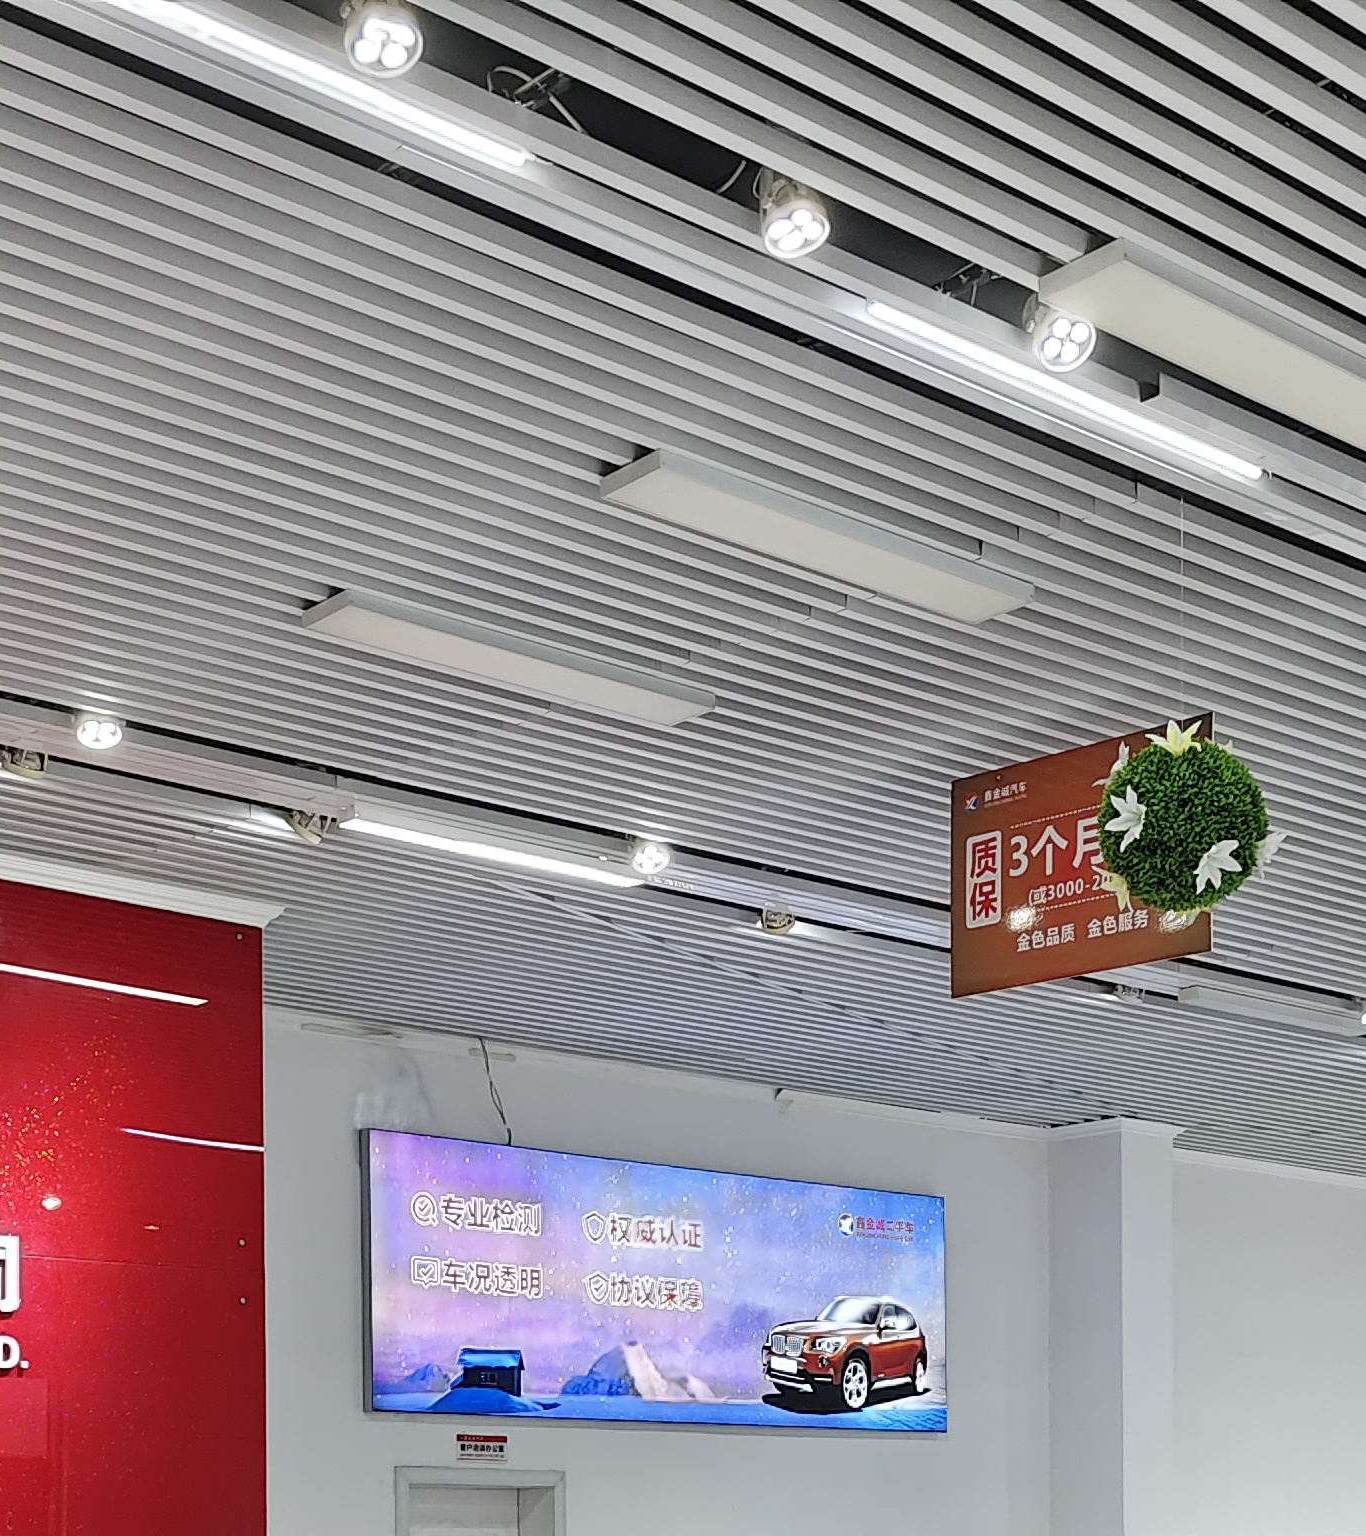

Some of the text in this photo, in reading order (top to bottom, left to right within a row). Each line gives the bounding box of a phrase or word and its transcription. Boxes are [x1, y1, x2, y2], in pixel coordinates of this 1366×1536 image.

[969, 837, 998, 921] 质保
[1017, 909, 1149, 952] 金色品质 金色服务
[441, 1194, 702, 1250] 专业检测 权威认证
[441, 1259, 703, 1310] 车况透明 协议保障
